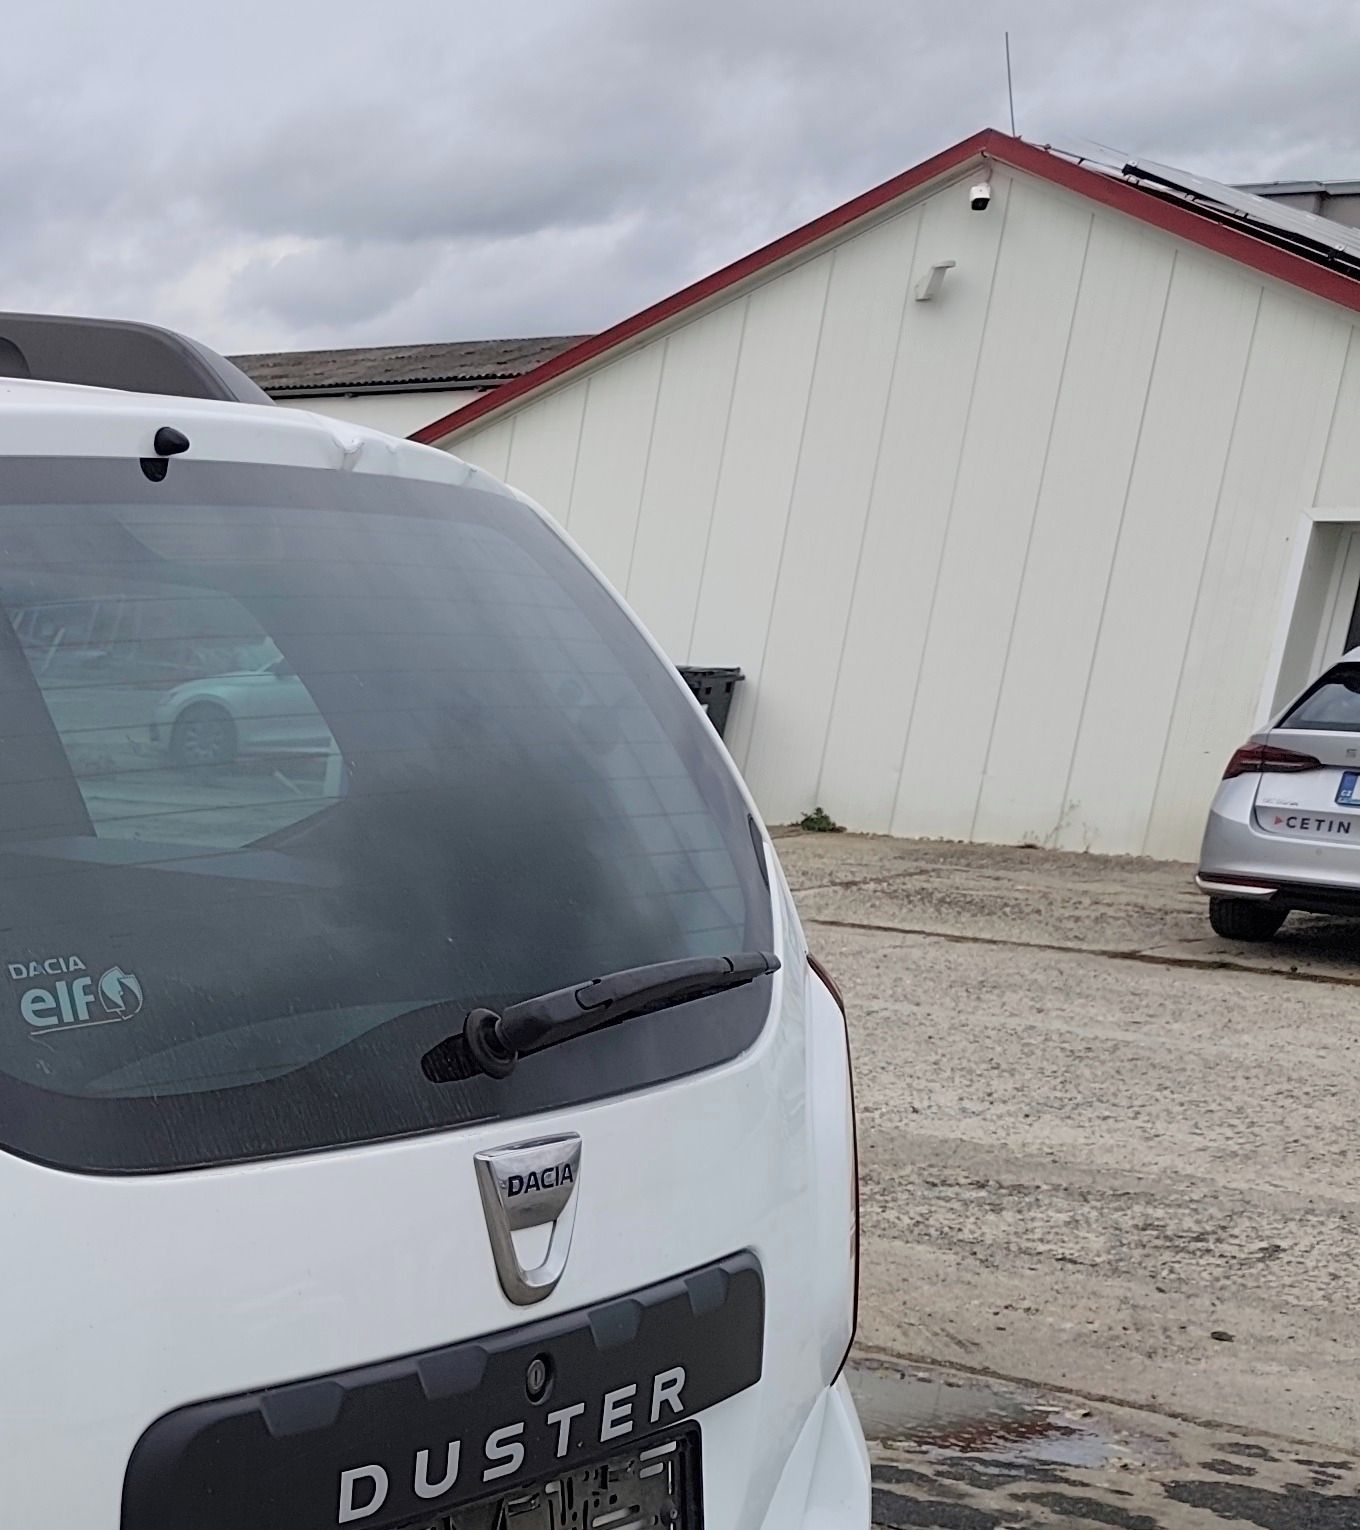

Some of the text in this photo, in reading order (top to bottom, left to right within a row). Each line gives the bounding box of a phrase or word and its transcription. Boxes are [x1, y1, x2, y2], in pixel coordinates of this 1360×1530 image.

[1286, 816, 1351, 834] CETIN
[8, 956, 87, 979] DACIA
[21, 976, 96, 1027] elf
[507, 1163, 573, 1197] DACIA
[337, 1366, 687, 1524] DUSTER
